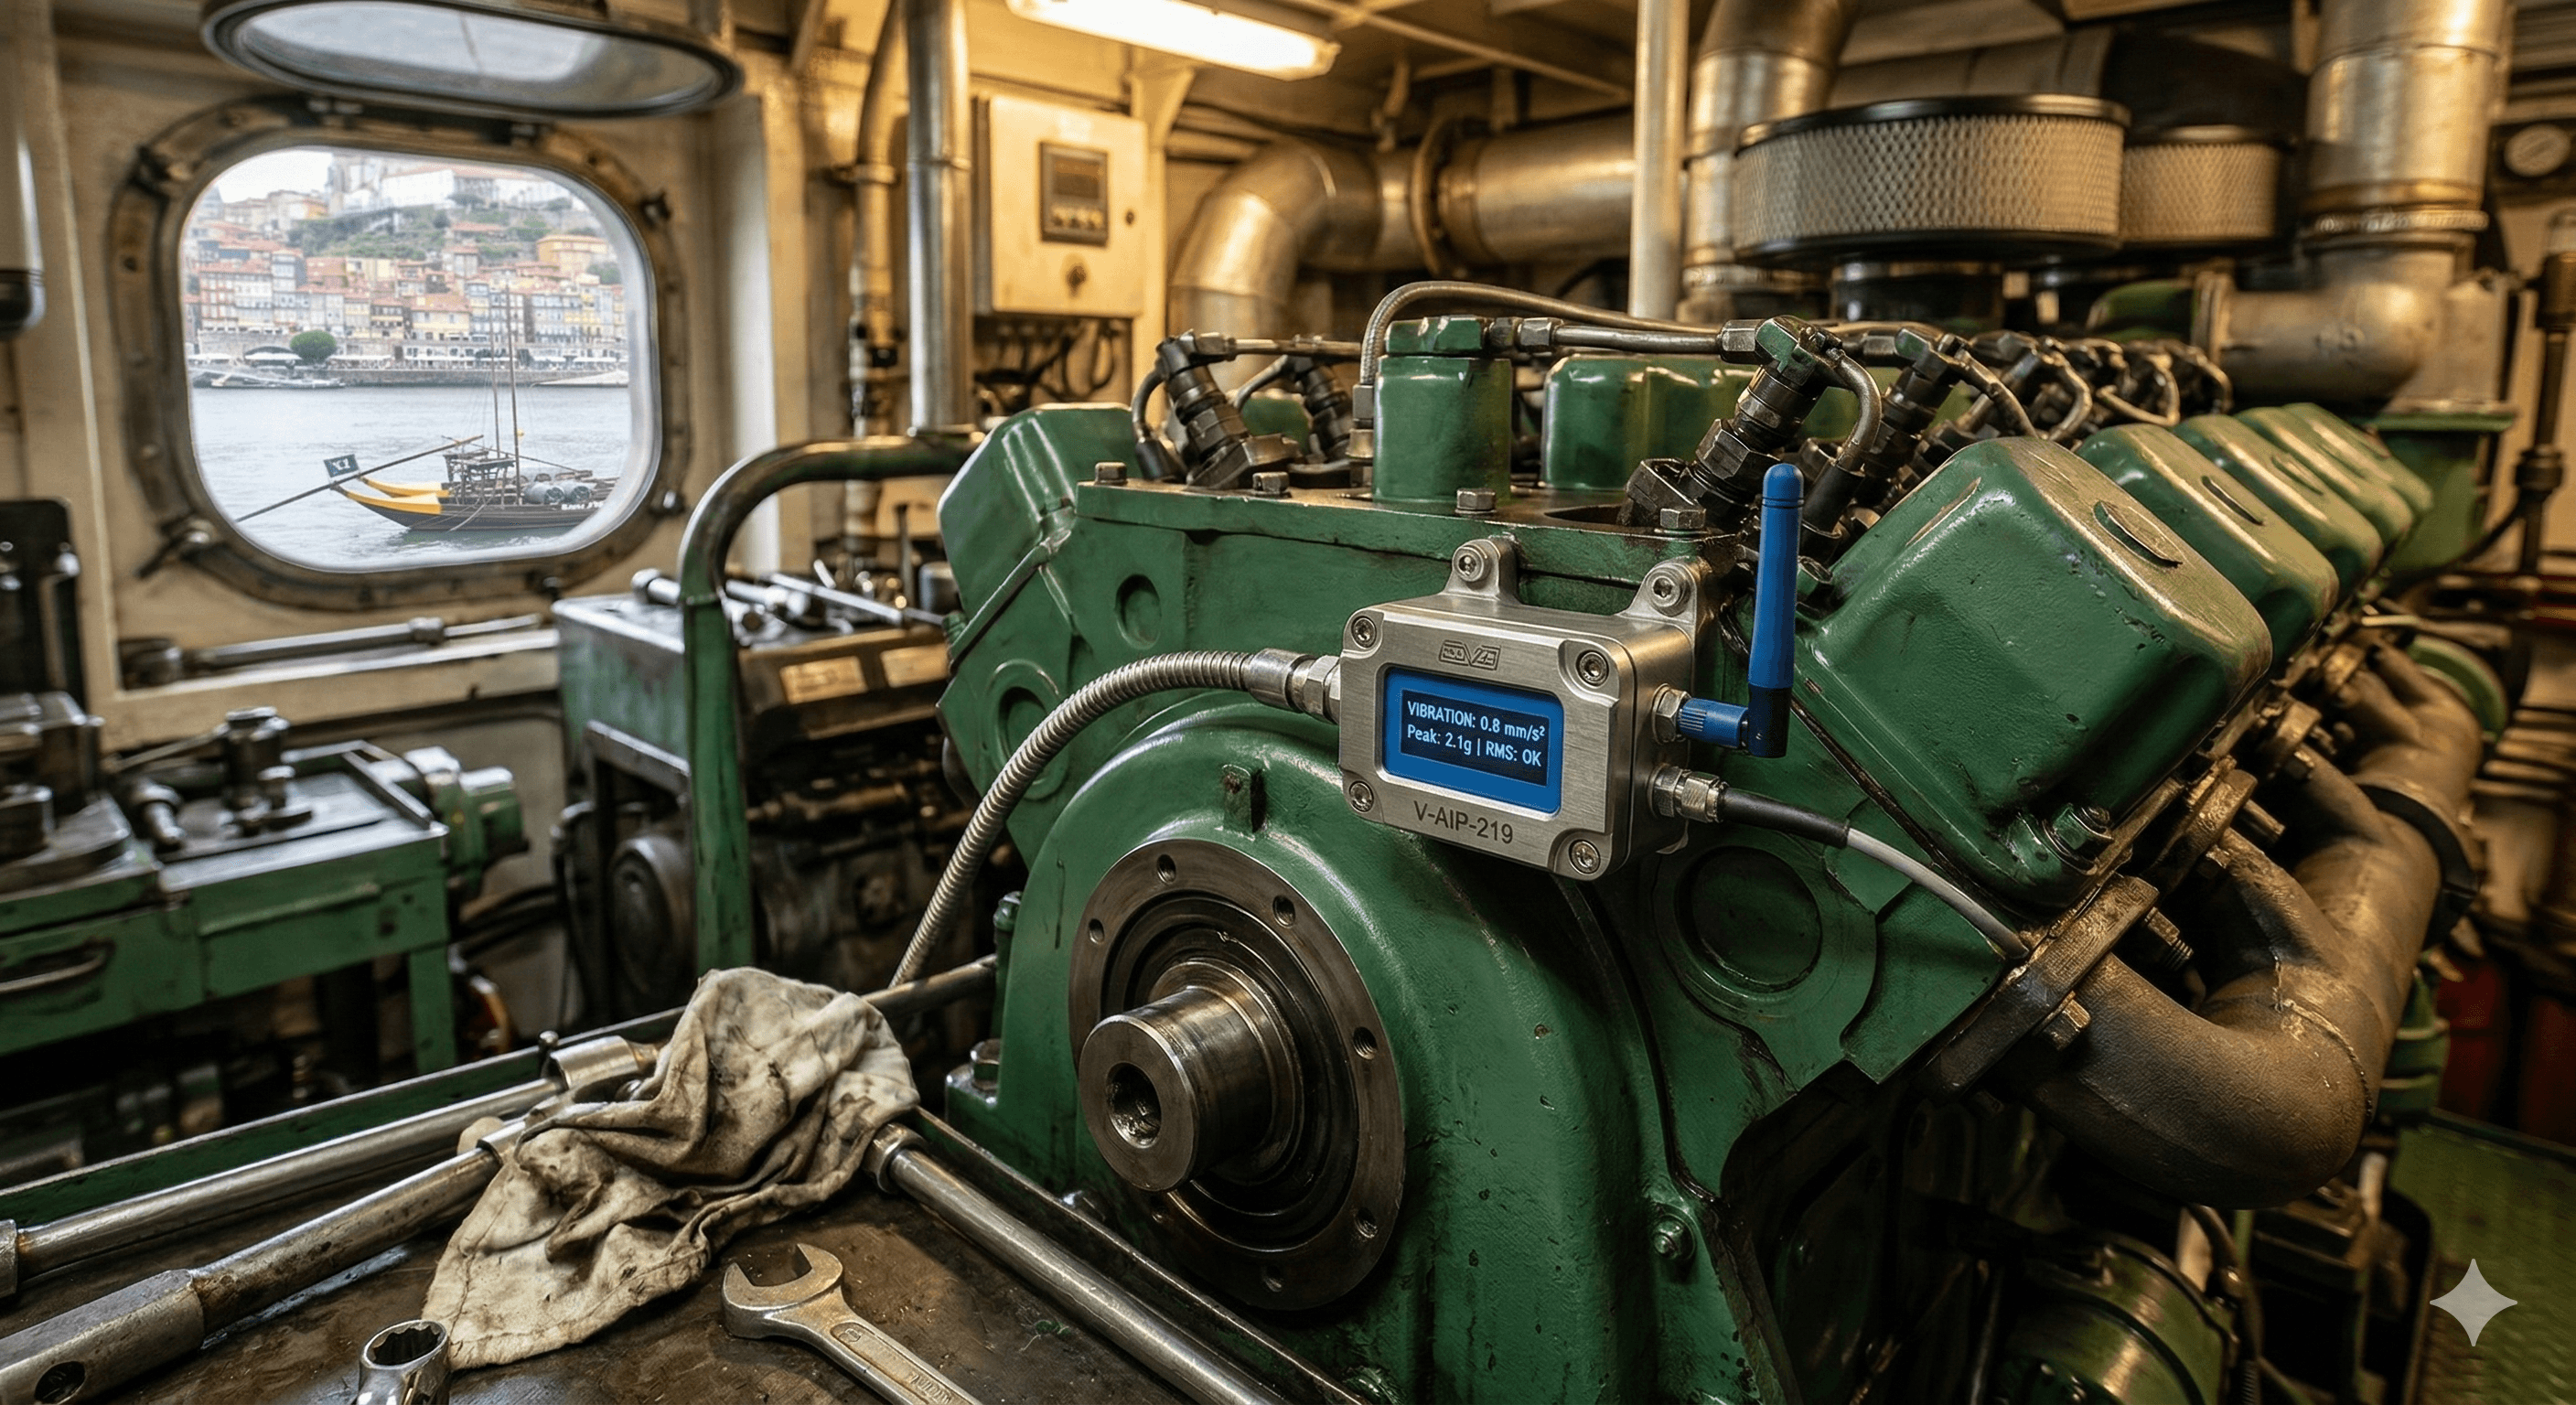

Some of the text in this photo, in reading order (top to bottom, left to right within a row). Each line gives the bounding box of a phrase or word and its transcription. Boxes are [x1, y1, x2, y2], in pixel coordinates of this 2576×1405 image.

[1407, 700, 1545, 742] VIBRATION: 0.8 mm/s²
[1407, 724, 1441, 745] Peak:
[1445, 732, 1472, 756] 2.1g
[1486, 740, 1518, 762] RMS:
[1521, 748, 1542, 767] OK
[1413, 799, 1513, 844] V-AIP-219
